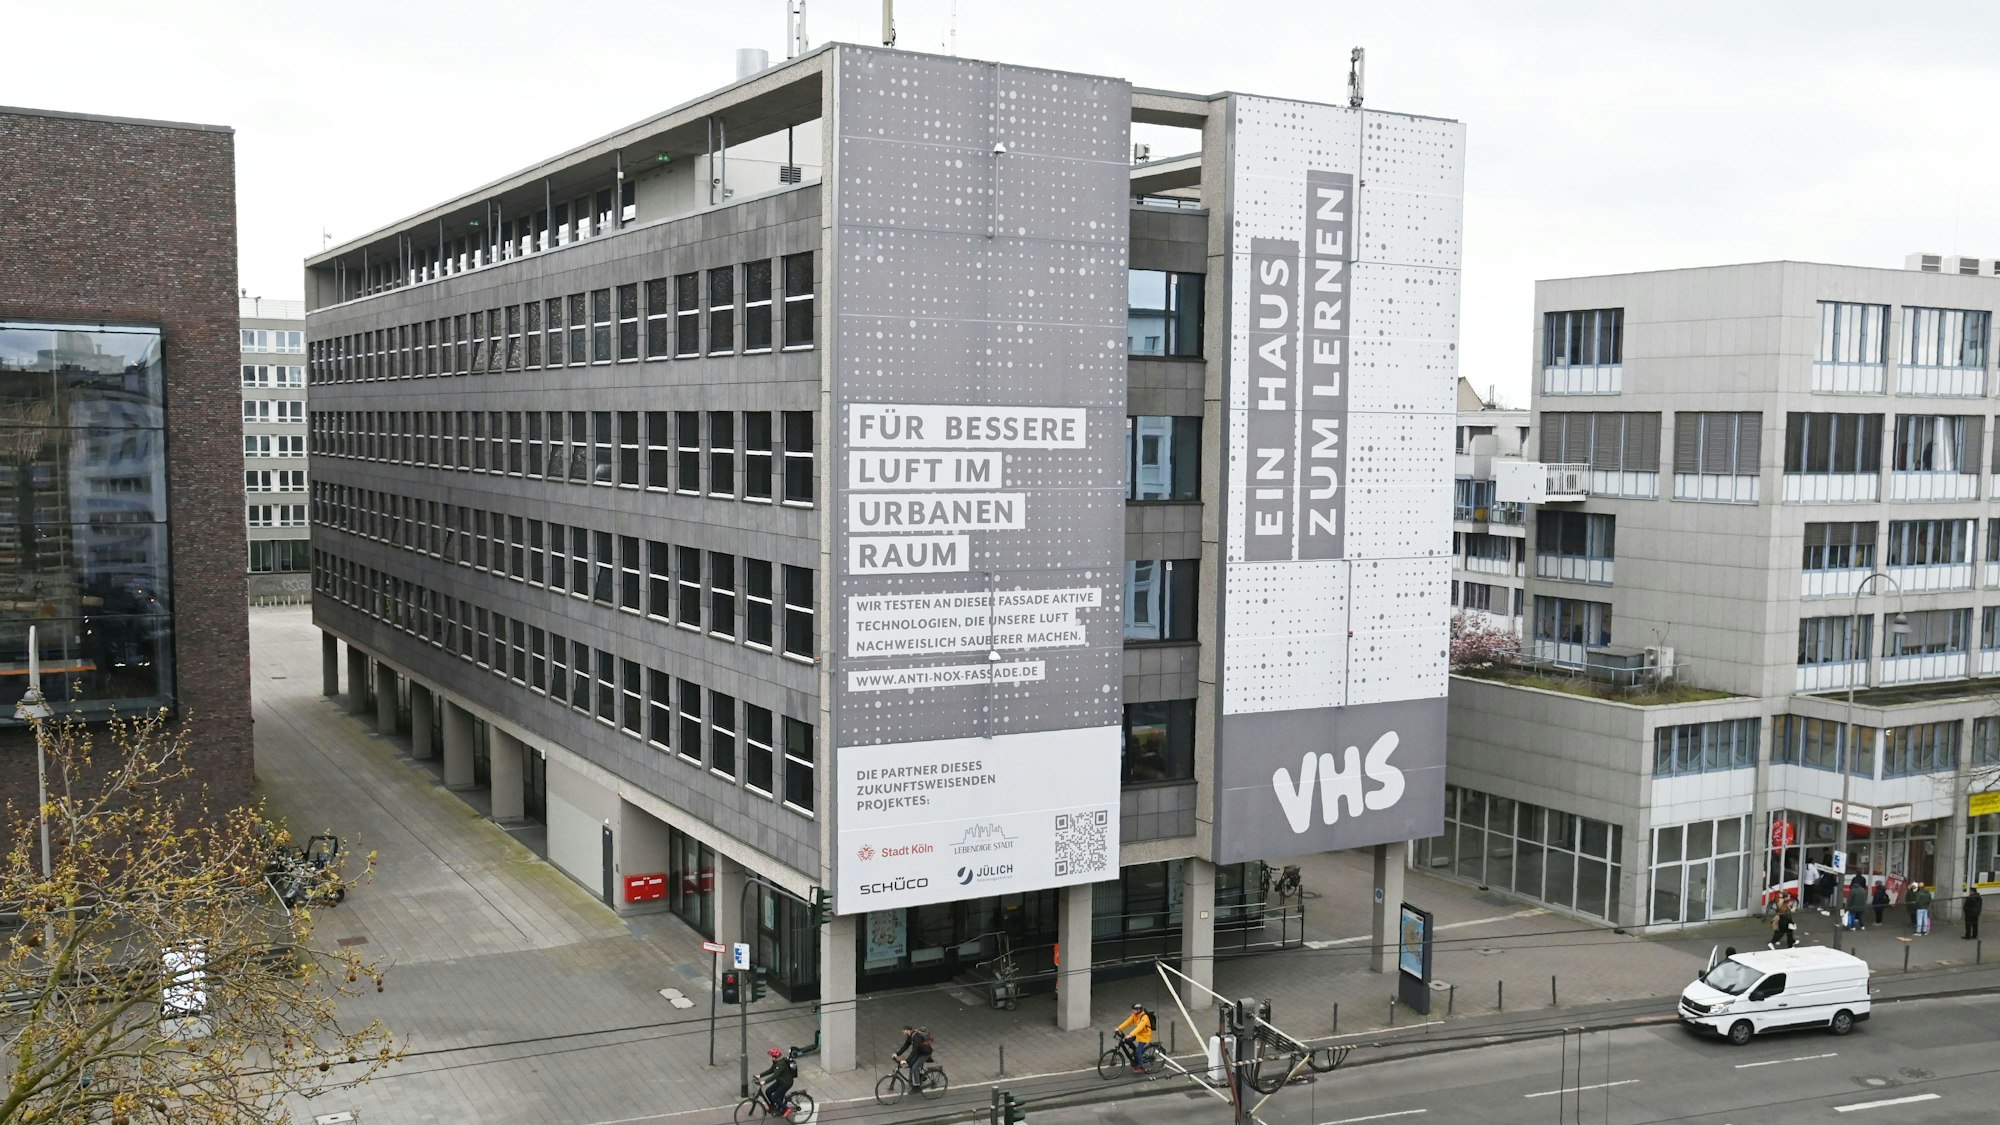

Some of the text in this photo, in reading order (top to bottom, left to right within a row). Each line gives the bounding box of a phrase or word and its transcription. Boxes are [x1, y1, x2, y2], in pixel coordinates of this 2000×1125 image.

[1308, 187, 1345, 536] ZUM LERNEN
[1254, 258, 1290, 536] EIN HAUS
[859, 409, 1076, 442] FÜR BESSERE
[859, 458, 991, 483] LUFT IM
[859, 500, 1014, 526] URBANEN
[859, 542, 957, 568] RAUM
[856, 592, 1094, 612] WIR TESTEN AN DIESER FASSADE AKTIVE
[856, 617, 962, 632] TECHNOLOGIEN,
[965, 616, 986, 627] DIE
[1039, 611, 1070, 623] LUFT
[856, 630, 1082, 652] NACHWEISLICH SAUBERER MACHEN.
[856, 666, 1038, 687] WWW.ANTI-NOX-FASSADE.DE
[856, 760, 983, 781] DIE PARTNER DIESES
[856, 774, 996, 796] ZUKUNFTSWEISENDEN
[1272, 730, 1406, 834] VHS
[856, 795, 931, 812] PROJEKTES:
[881, 843, 934, 858] Stadt Köln
[954, 842, 992, 855] LEBENDIGE
[993, 840, 1014, 851] STADT
[976, 864, 1013, 877] JÜLICH
[860, 877, 928, 895] SCHÜCO
